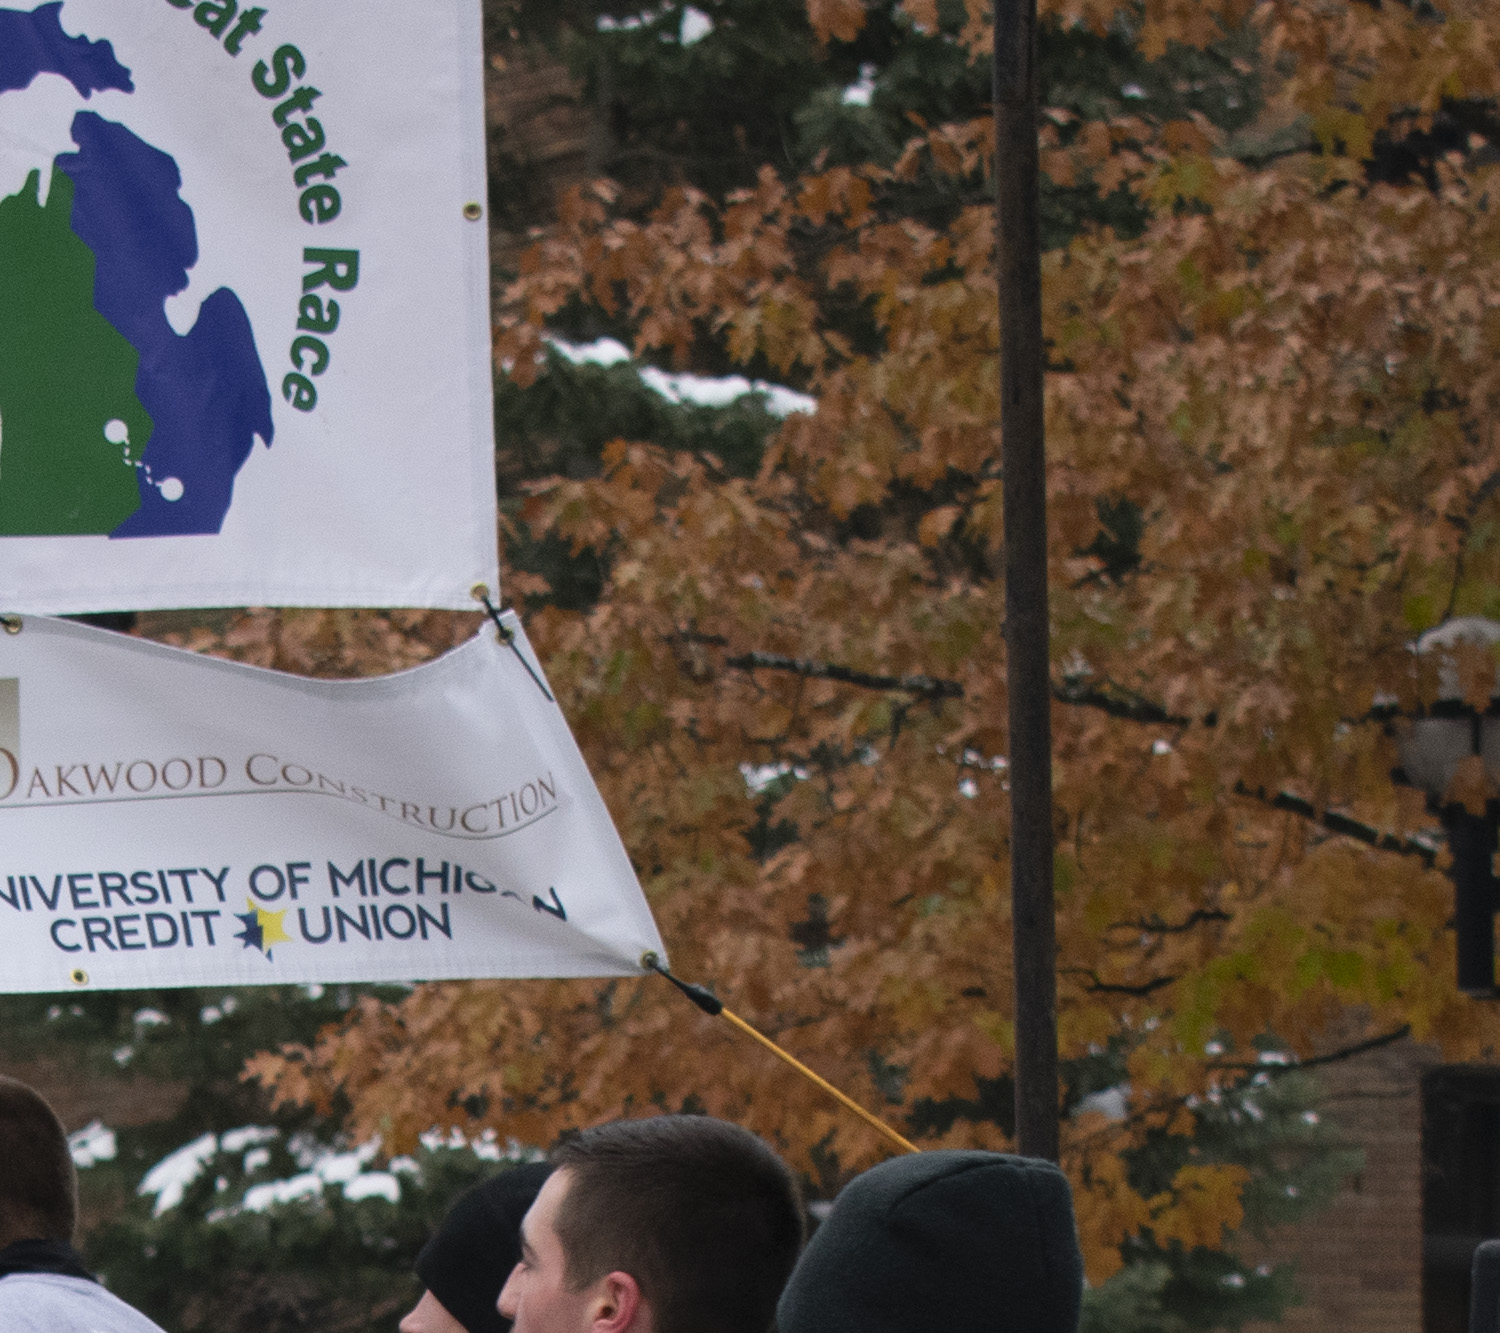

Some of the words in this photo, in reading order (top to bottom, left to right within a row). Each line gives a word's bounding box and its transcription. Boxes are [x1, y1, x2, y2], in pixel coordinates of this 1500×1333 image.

[252, 43, 348, 226] State
[281, 247, 361, 414] Race
[242, 751, 558, 837] CONSTRUCTION
[49, 908, 222, 954] CREDIT
[299, 902, 453, 948] UNION
[248, 861, 311, 902] OF
[327, 856, 568, 923] MICHIGN
